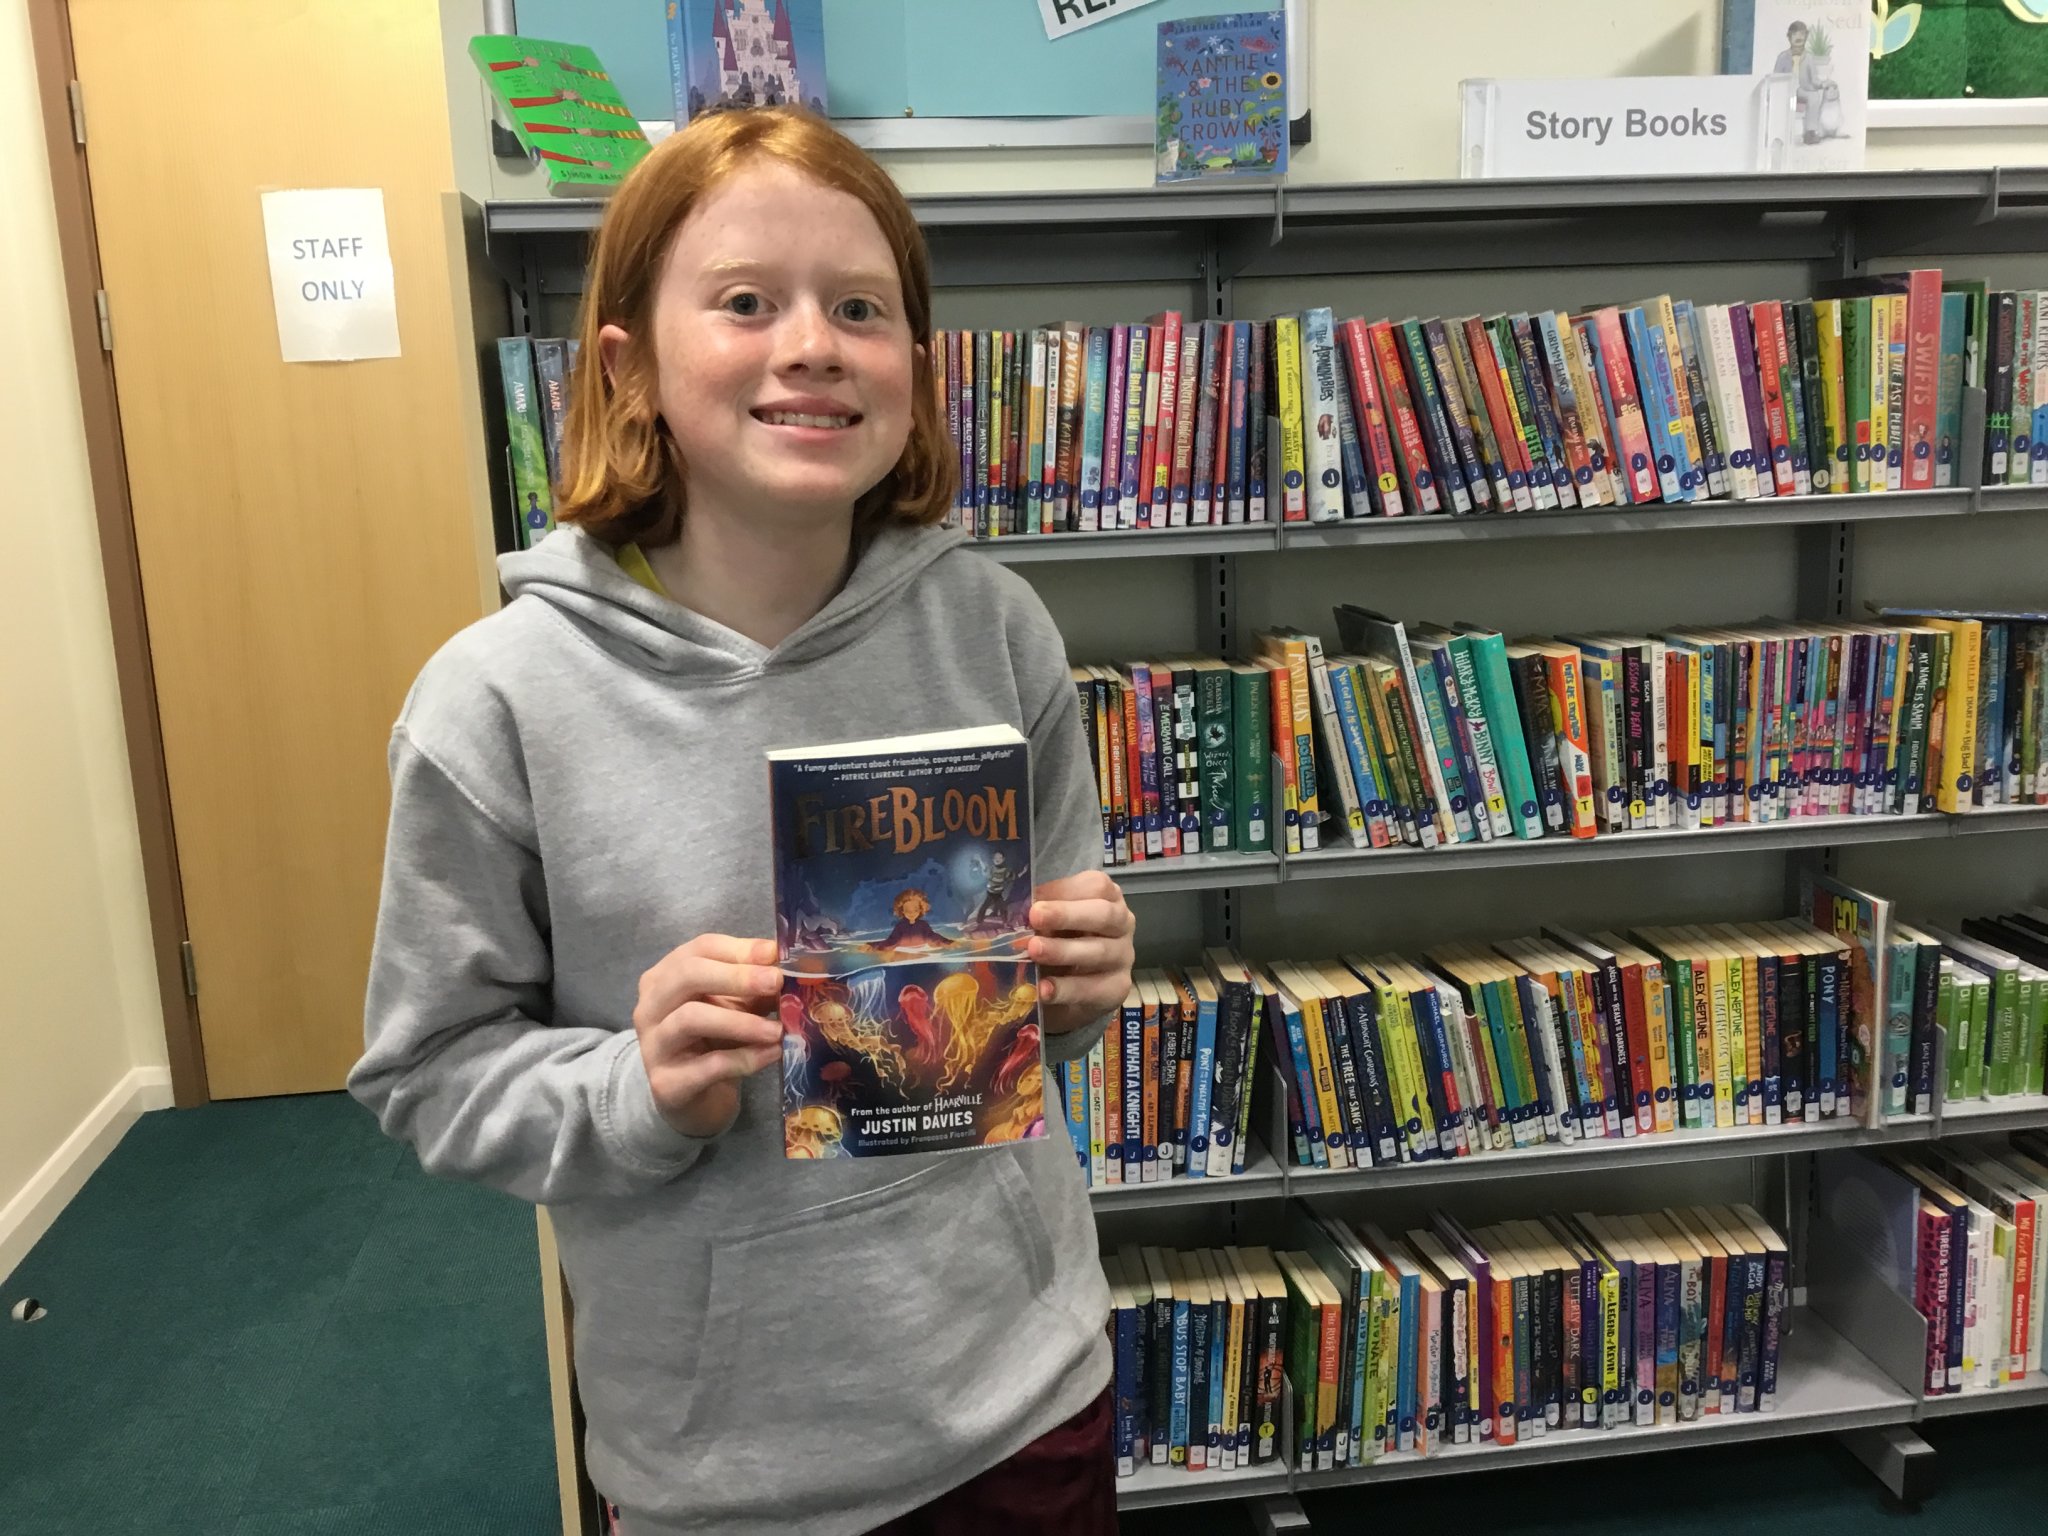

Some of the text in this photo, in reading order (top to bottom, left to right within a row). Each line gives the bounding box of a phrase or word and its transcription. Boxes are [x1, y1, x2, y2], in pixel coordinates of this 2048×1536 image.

[1177, 52, 1260, 78] XANTHE
[1188, 75, 1250, 97] & THE
[1191, 97, 1245, 119] RUBY
[1180, 118, 1256, 142] CROWN
[1526, 107, 1728, 147] Story Books
[292, 237, 364, 260] STAFF
[301, 280, 365, 302] ONLY
[1235, 337, 1245, 370] SAMMY
[1410, 330, 1435, 397] LIS JARDINE
[1519, 337, 1535, 367] Amir
[1546, 330, 1570, 395] GRIMMELINGS
[1715, 351, 1727, 377] LEAN
[1914, 332, 1935, 405] SWIFTS
[1089, 336, 1103, 413] GUY SCRAP
[1162, 341, 1177, 413] NINA PEANUT
[1362, 370, 1374, 400] MYSTERY
[1689, 371, 1702, 397] GHOST
[1778, 337, 1797, 440] TRAVEL SUPERPOWER
[2018, 369, 2031, 406] WOODS
[513, 381, 527, 414] AMARI
[548, 379, 562, 412] AMARI
[1059, 330, 1080, 457] FOXLIGHT KATYA
[1178, 375, 1196, 444] Mystery Golden
[1763, 348, 1782, 439] LEONARD FEATHER
[1889, 358, 1902, 446] THE LAST PEBBLE
[1128, 407, 1142, 430] NEW
[1342, 423, 1356, 444] PLOT
[979, 428, 988, 464] MENOX
[1524, 424, 1544, 460] AFTER
[1327, 473, 1335, 485] J
[1383, 477, 1392, 488] T
[1401, 643, 1412, 668] Horace
[1205, 677, 1214, 714] COWELL
[1214, 676, 1223, 714] CRESSIDA
[1280, 679, 1291, 728] MARK LOWERY
[1288, 653, 1309, 722] MATT LUCAS
[1628, 657, 1641, 738] LESSONS IN DEATH
[1702, 674, 1712, 701] MUM
[1911, 652, 1929, 730] MY NAME IS SAMIM
[1960, 631, 1977, 769] BEN MILLER DIARY Big Bad
[1160, 712, 1173, 778] MERMAID CALL
[1474, 730, 1495, 766] BINNY
[804, 764, 827, 773] funny
[828, 762, 868, 772] adventure
[869, 759, 891, 769] about
[932, 755, 962, 766] courage
[841, 772, 870, 781] PATRICE
[908, 766, 933, 777] AUTHOR
[934, 766, 943, 775] OF
[1634, 804, 1641, 813] T
[1731, 967, 1743, 1037] ALEX NEPTUNE
[1765, 967, 1776, 1036] ALEX NEPTUNE
[1821, 965, 1835, 1004] PONY
[1336, 999, 1345, 1017] Serena
[1694, 970, 1708, 1040] ALEX NEPTUNE
[1227, 1011, 1241, 1038] BOOK
[1429, 993, 1449, 1068] MICHAEL MORPURGO
[1611, 1002, 1626, 1065] REALM DARKNESS
[2001, 1007, 2013, 1063] PIZZA DETECTIVE
[1166, 1032, 1177, 1085] EMBER SPARK
[1200, 1048, 1211, 1070] PONY
[1248, 1047, 1256, 1069] TITANS
[1340, 1044, 1350, 1058] THE
[1357, 1012, 1379, 1087] MIDNIGHT GUARDIANS
[1921, 1042, 1931, 1059] SKIN
[1126, 1020, 1140, 1139] OH WHAT A KNIGHT!
[1342, 1060, 1355, 1083] TREE
[851, 1107, 873, 1117] From
[876, 1106, 890, 1115] the
[891, 1103, 921, 1114] author
[923, 1102, 932, 1111] of
[1070, 1087, 1084, 1124] TRAP
[1722, 1088, 1728, 1096] T
[861, 1110, 973, 1135] JUSTIN DAVIES
[1109, 1113, 1118, 1129] Phil
[1349, 1101, 1361, 1124] SANG
[900, 1136, 910, 1145] by
[1162, 1146, 1169, 1156] J
[1747, 1262, 1756, 1289] SAGAR
[1755, 1264, 1763, 1287] ANDY
[1938, 1229, 1950, 1303] TIRED TESTED
[2016, 1217, 2030, 1316] MY MEALS Grace
[1520, 1280, 1528, 1312] ROMESH
[1621, 1277, 1629, 1312] COACH
[1638, 1267, 1653, 1308] ALIYA
[1663, 1269, 1678, 1305] ALIYA
[1686, 1281, 1696, 1303] BOY
[1570, 1275, 1580, 1359] UTTERLY DARK
[1606, 1302, 1617, 1375] LEGEND KEVIN
[1174, 1319, 1187, 1405] BUS STOP BABY
[1369, 1341, 1380, 1379] NATE
